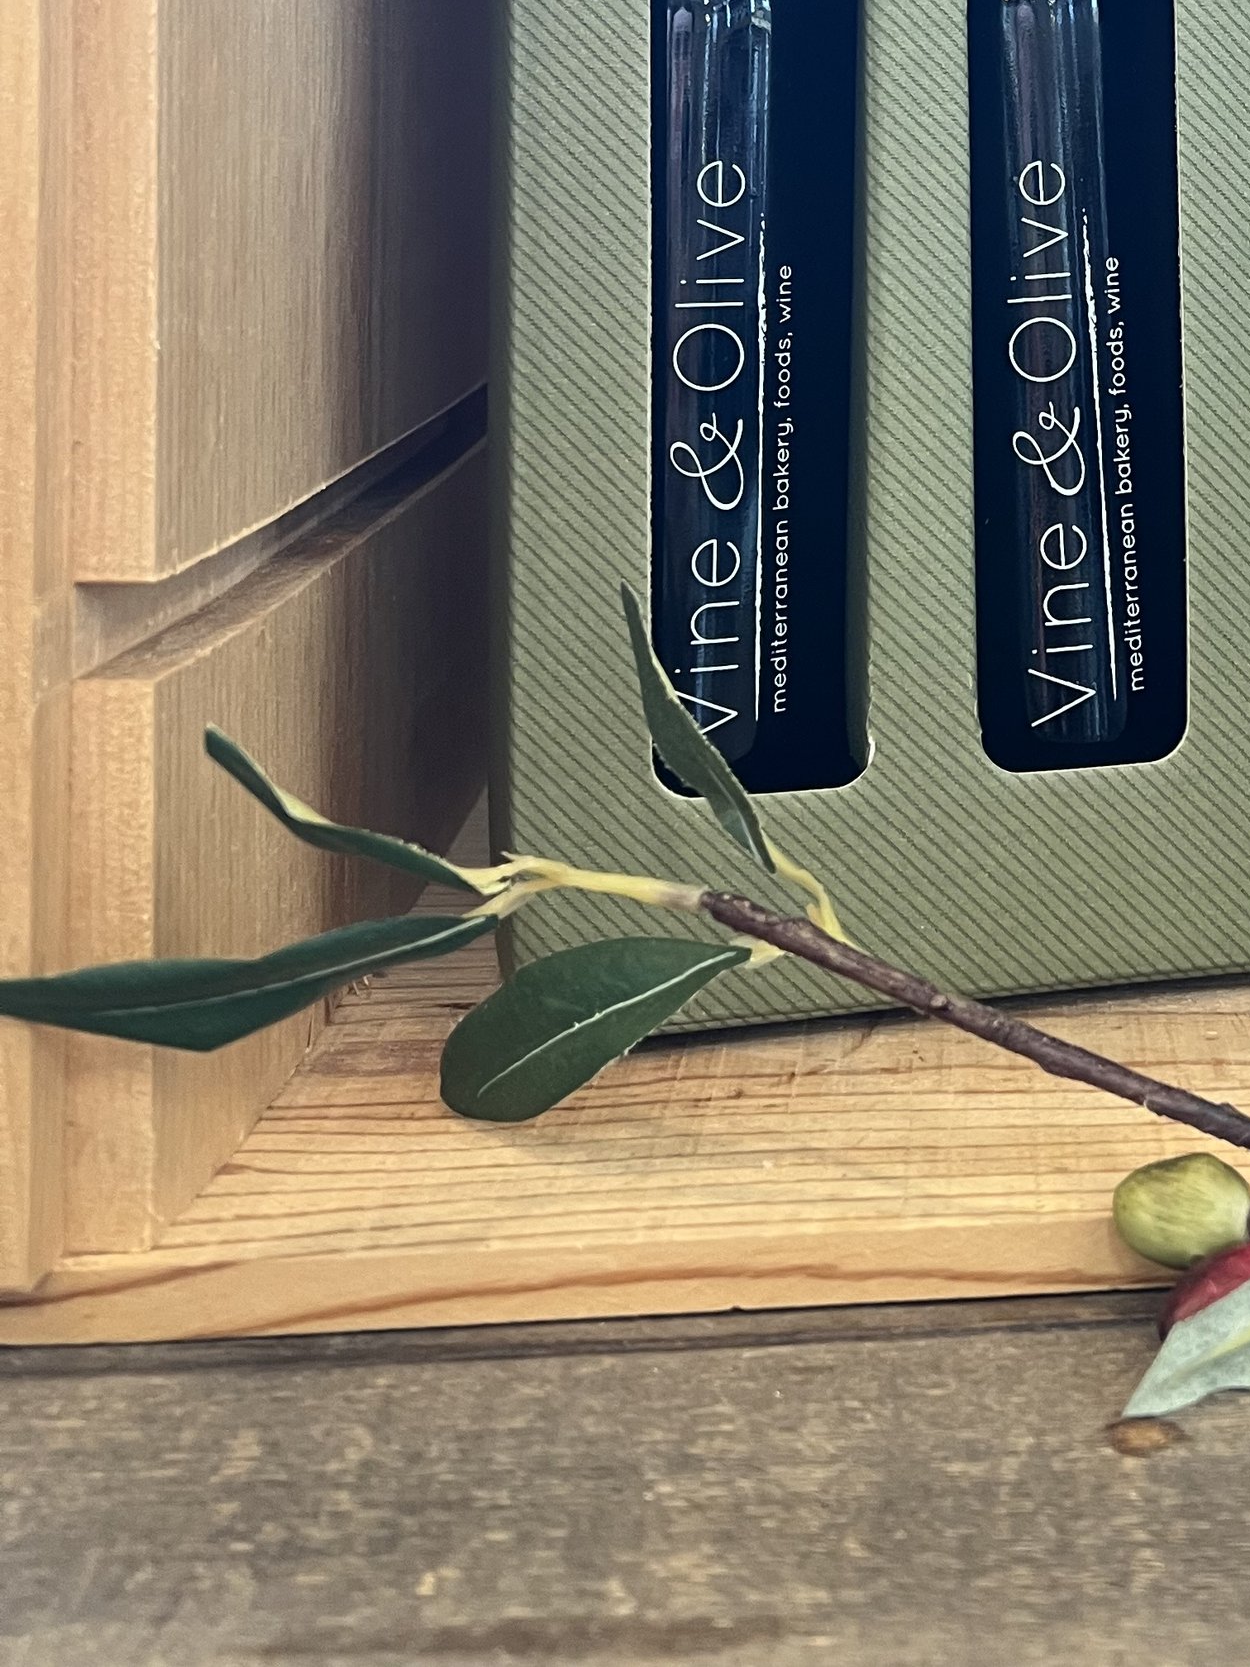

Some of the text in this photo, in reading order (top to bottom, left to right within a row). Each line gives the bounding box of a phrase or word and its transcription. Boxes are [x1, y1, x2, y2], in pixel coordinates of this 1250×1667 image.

[669, 160, 746, 735] Vine & Olive
[770, 265, 794, 713] mediterranean bakery, foods, wine
[1008, 160, 1097, 727] Vine & Olive
[1105, 257, 1145, 691] mediterranean bakery, foods, wine
